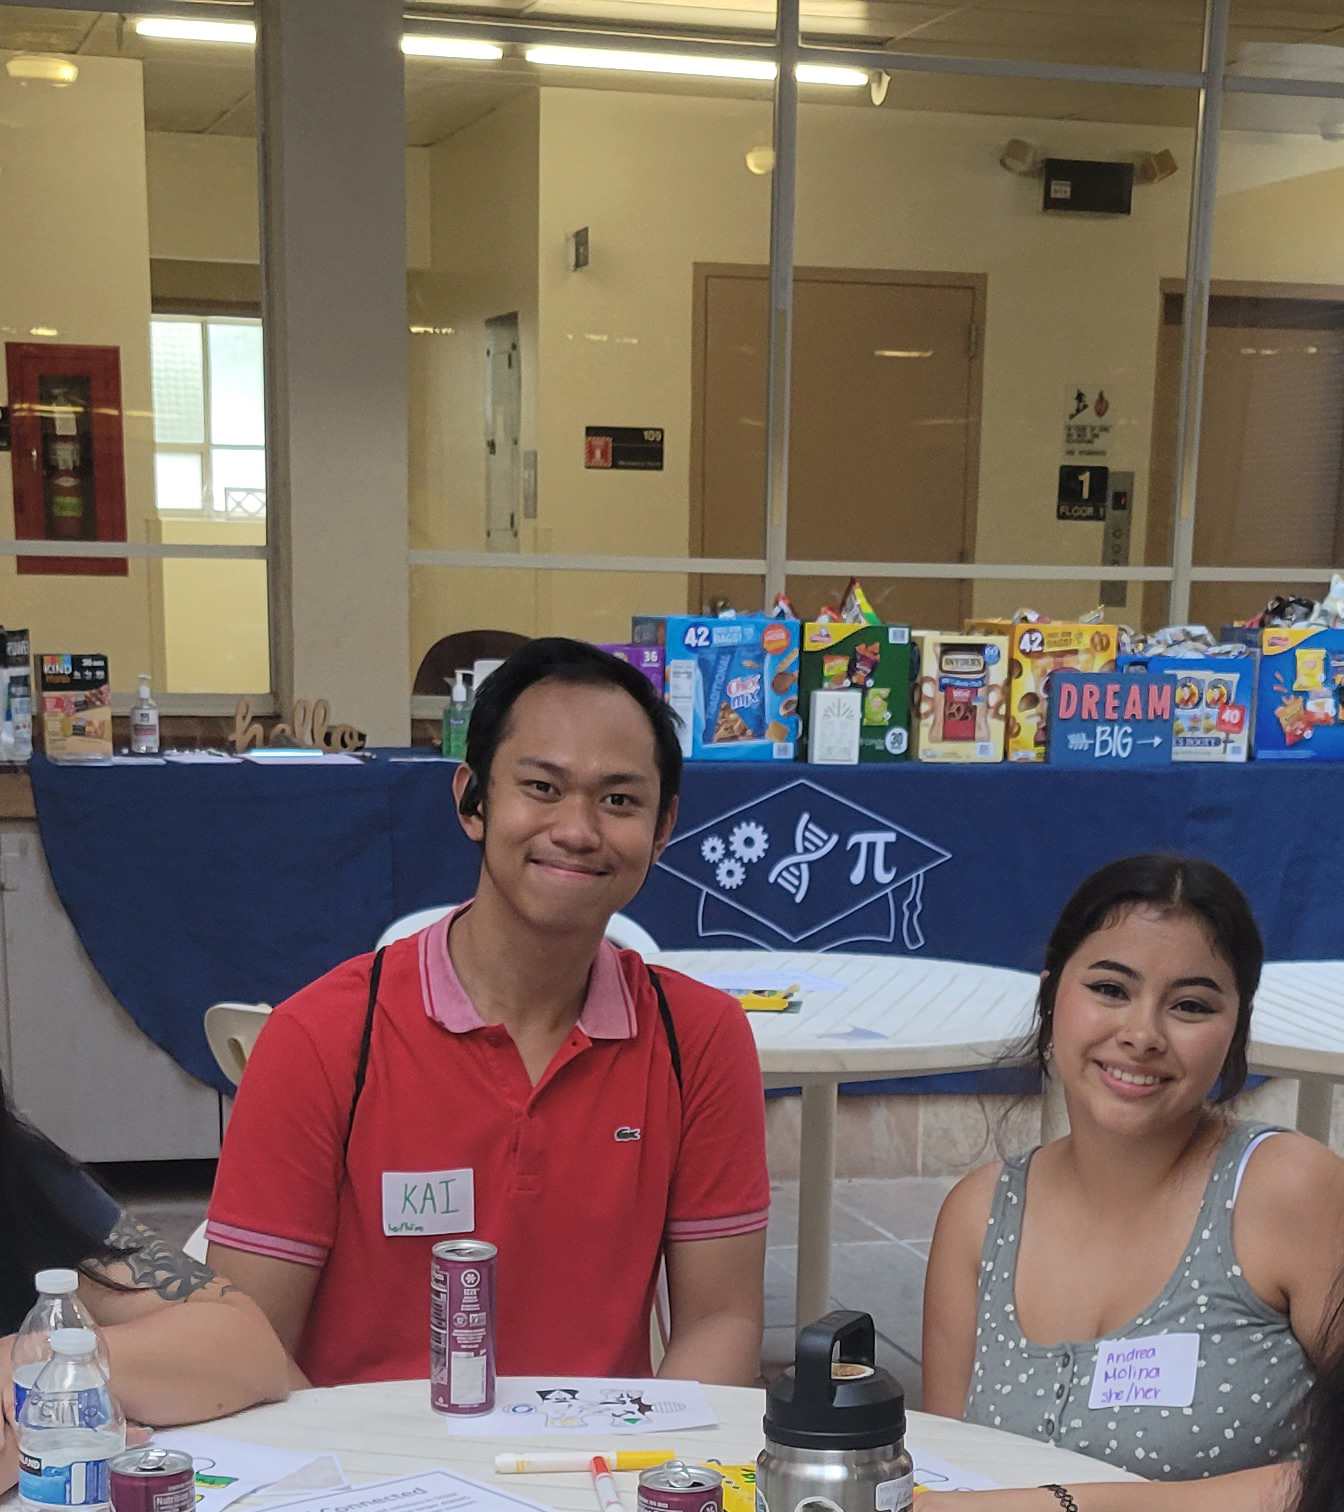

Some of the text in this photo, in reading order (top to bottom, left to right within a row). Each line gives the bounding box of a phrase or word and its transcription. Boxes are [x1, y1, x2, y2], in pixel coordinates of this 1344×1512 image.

[643, 430, 662, 441] 109
[1077, 471, 1091, 500] 1
[1059, 506, 1094, 517] FLOOR
[684, 626, 711, 648] 42
[1019, 631, 1043, 653] 42
[43, 664, 73, 675] KIND
[1058, 683, 1172, 720] DREAM
[1221, 707, 1242, 725] 40
[890, 732, 904, 746] 30
[1094, 723, 1133, 759] BIG
[401, 1178, 460, 1215] KAI
[387, 1222, 424, 1233] he/him
[1106, 1347, 1156, 1365] Andrea
[1103, 1364, 1160, 1383] Molina
[1100, 1382, 1162, 1404] she/her
